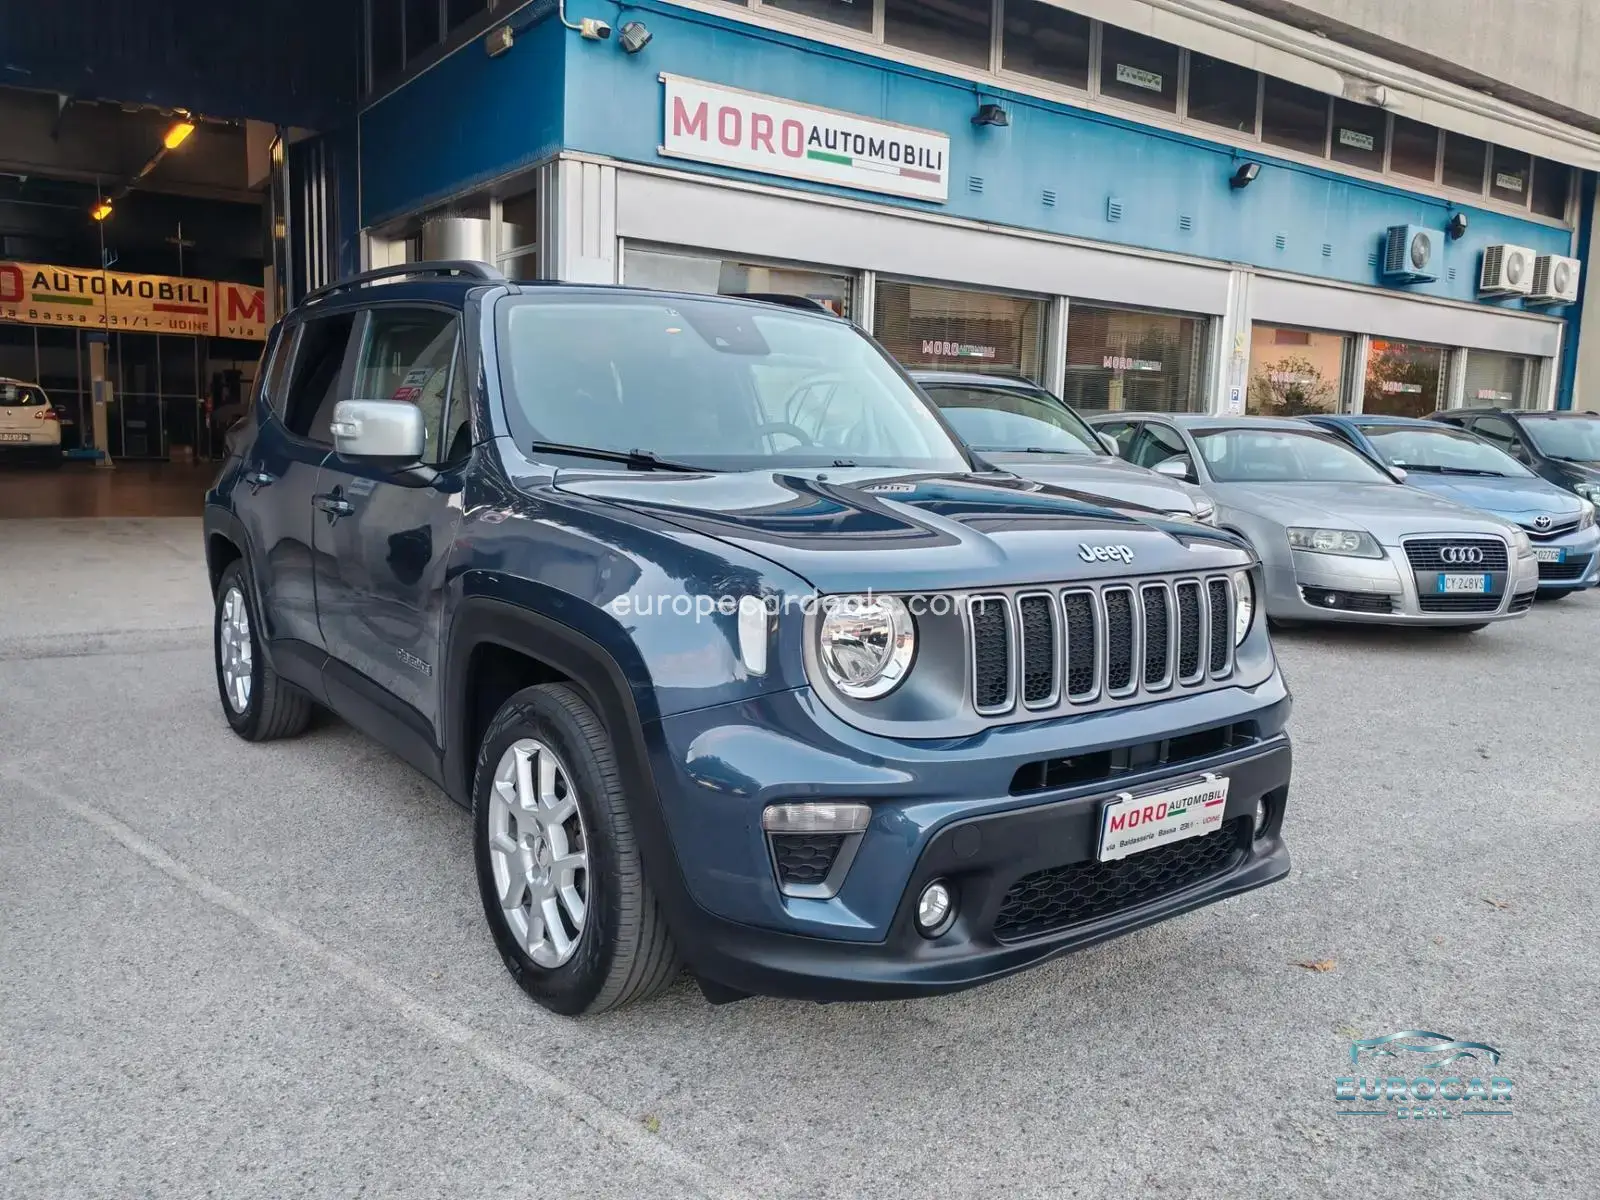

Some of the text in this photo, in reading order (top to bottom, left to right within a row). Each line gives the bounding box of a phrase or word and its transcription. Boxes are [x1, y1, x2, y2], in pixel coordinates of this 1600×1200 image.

[673, 96, 942, 170] MORO AUTOMOBILI
[32, 271, 209, 304] AUTOMOBILI
[29, 308, 87, 323] Bassa
[99, 314, 149, 328] 231/1
[169, 319, 208, 332] UDINE
[228, 326, 254, 336] via
[922, 339, 959, 356] MORO
[1103, 355, 1133, 370] MORO
[1078, 543, 1134, 564] Jeep
[1110, 789, 1226, 833] MORO AUTOMOBILI
[1106, 843, 1116, 851] via
